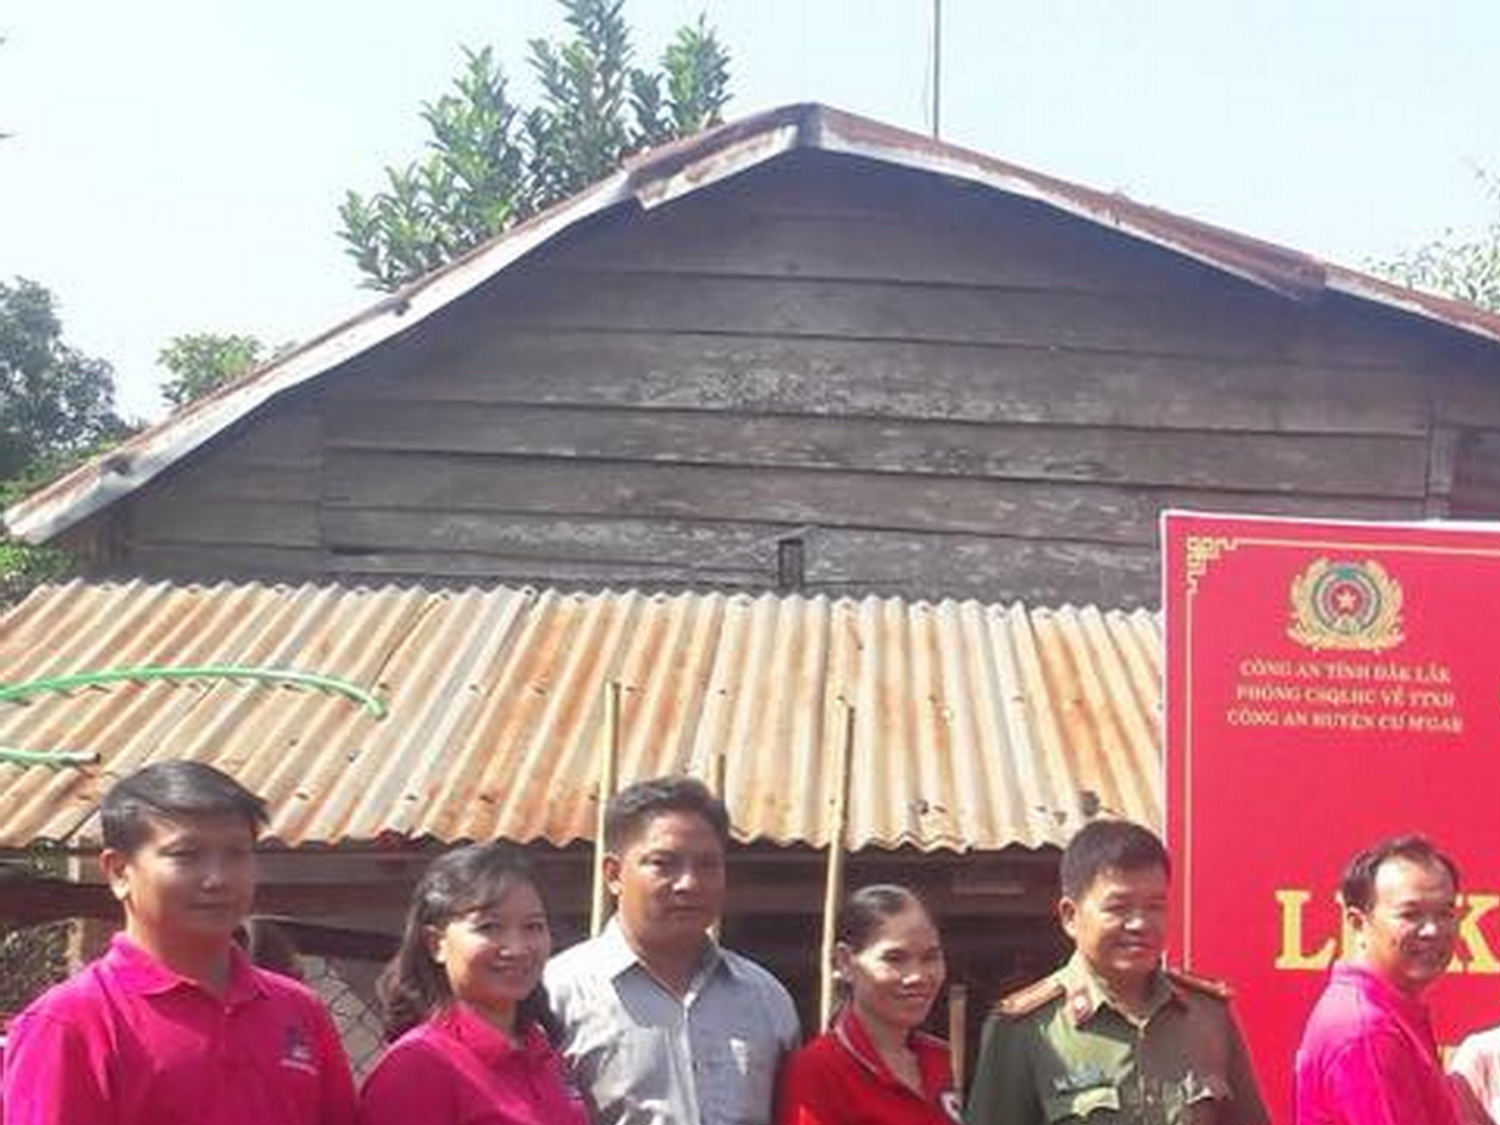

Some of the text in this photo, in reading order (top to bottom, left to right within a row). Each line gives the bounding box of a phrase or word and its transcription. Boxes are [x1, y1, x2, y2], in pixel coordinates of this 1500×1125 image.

[1239, 659, 1292, 677] CÔNG
[1296, 662, 1321, 678] AN
[1227, 708, 1279, 726] CÔNG
[1283, 711, 1308, 726] AN
